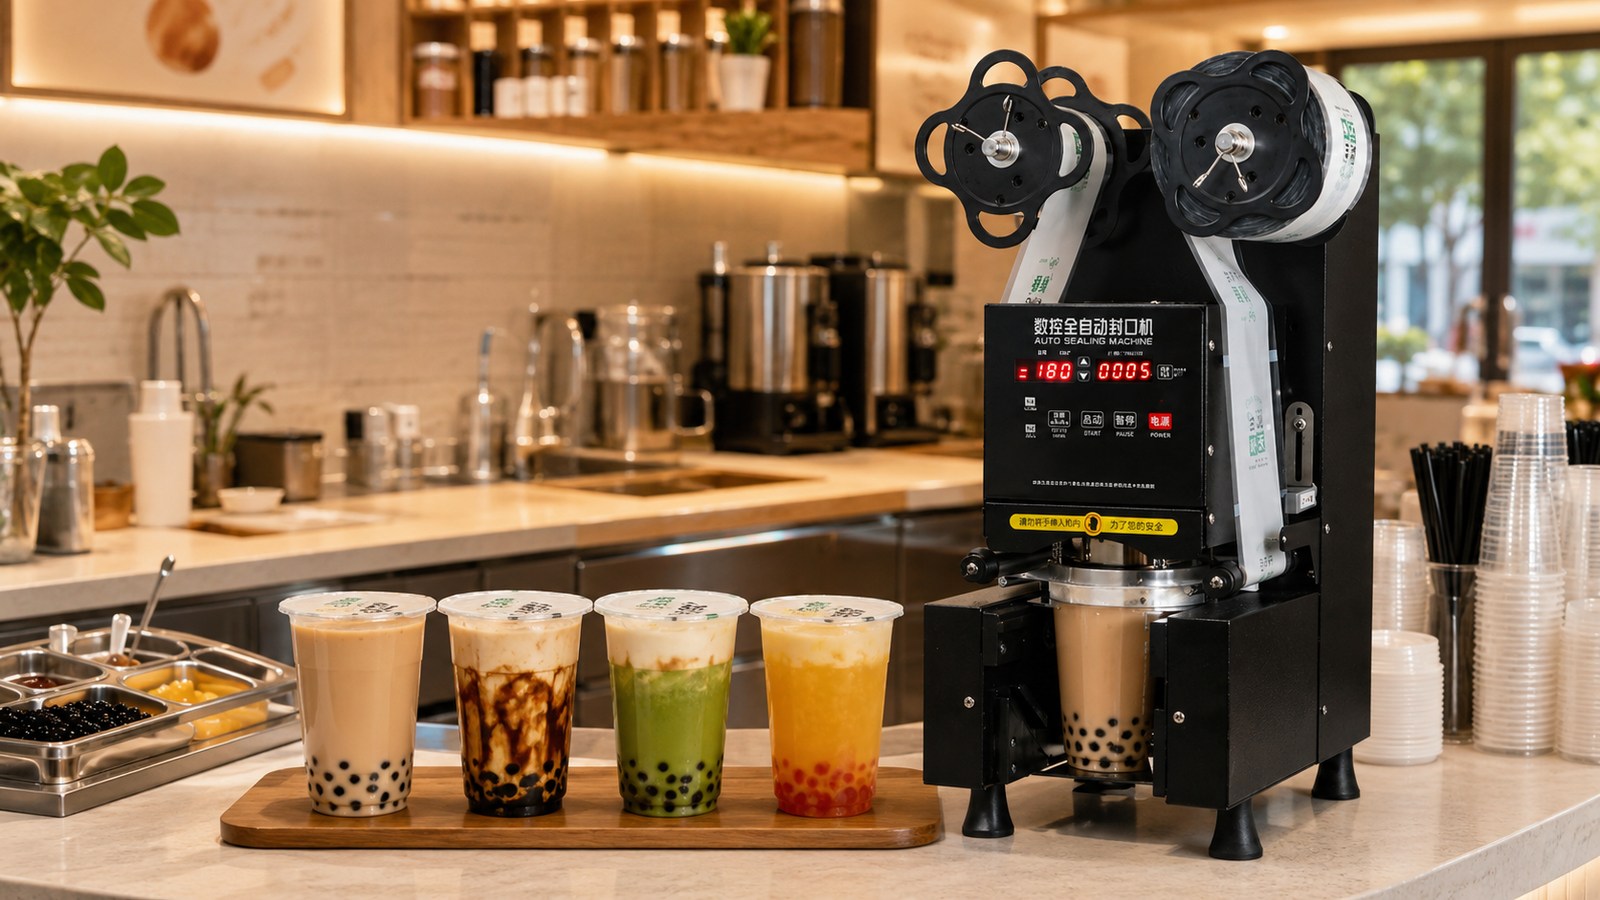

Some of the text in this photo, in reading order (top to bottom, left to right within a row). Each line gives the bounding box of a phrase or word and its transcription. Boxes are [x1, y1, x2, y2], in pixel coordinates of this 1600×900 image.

[1034, 317, 1153, 336] 数控全自动封口机
[1034, 337, 1153, 346] AUTO SEALING MACHINE
[1038, 362, 1072, 380] 180
[1098, 362, 1150, 379] 0005
[1150, 415, 1171, 428] 电源
[1115, 430, 1135, 438] PAUSE
[1150, 431, 1172, 439] POWER
[1109, 519, 1164, 532] 为了您的安全
